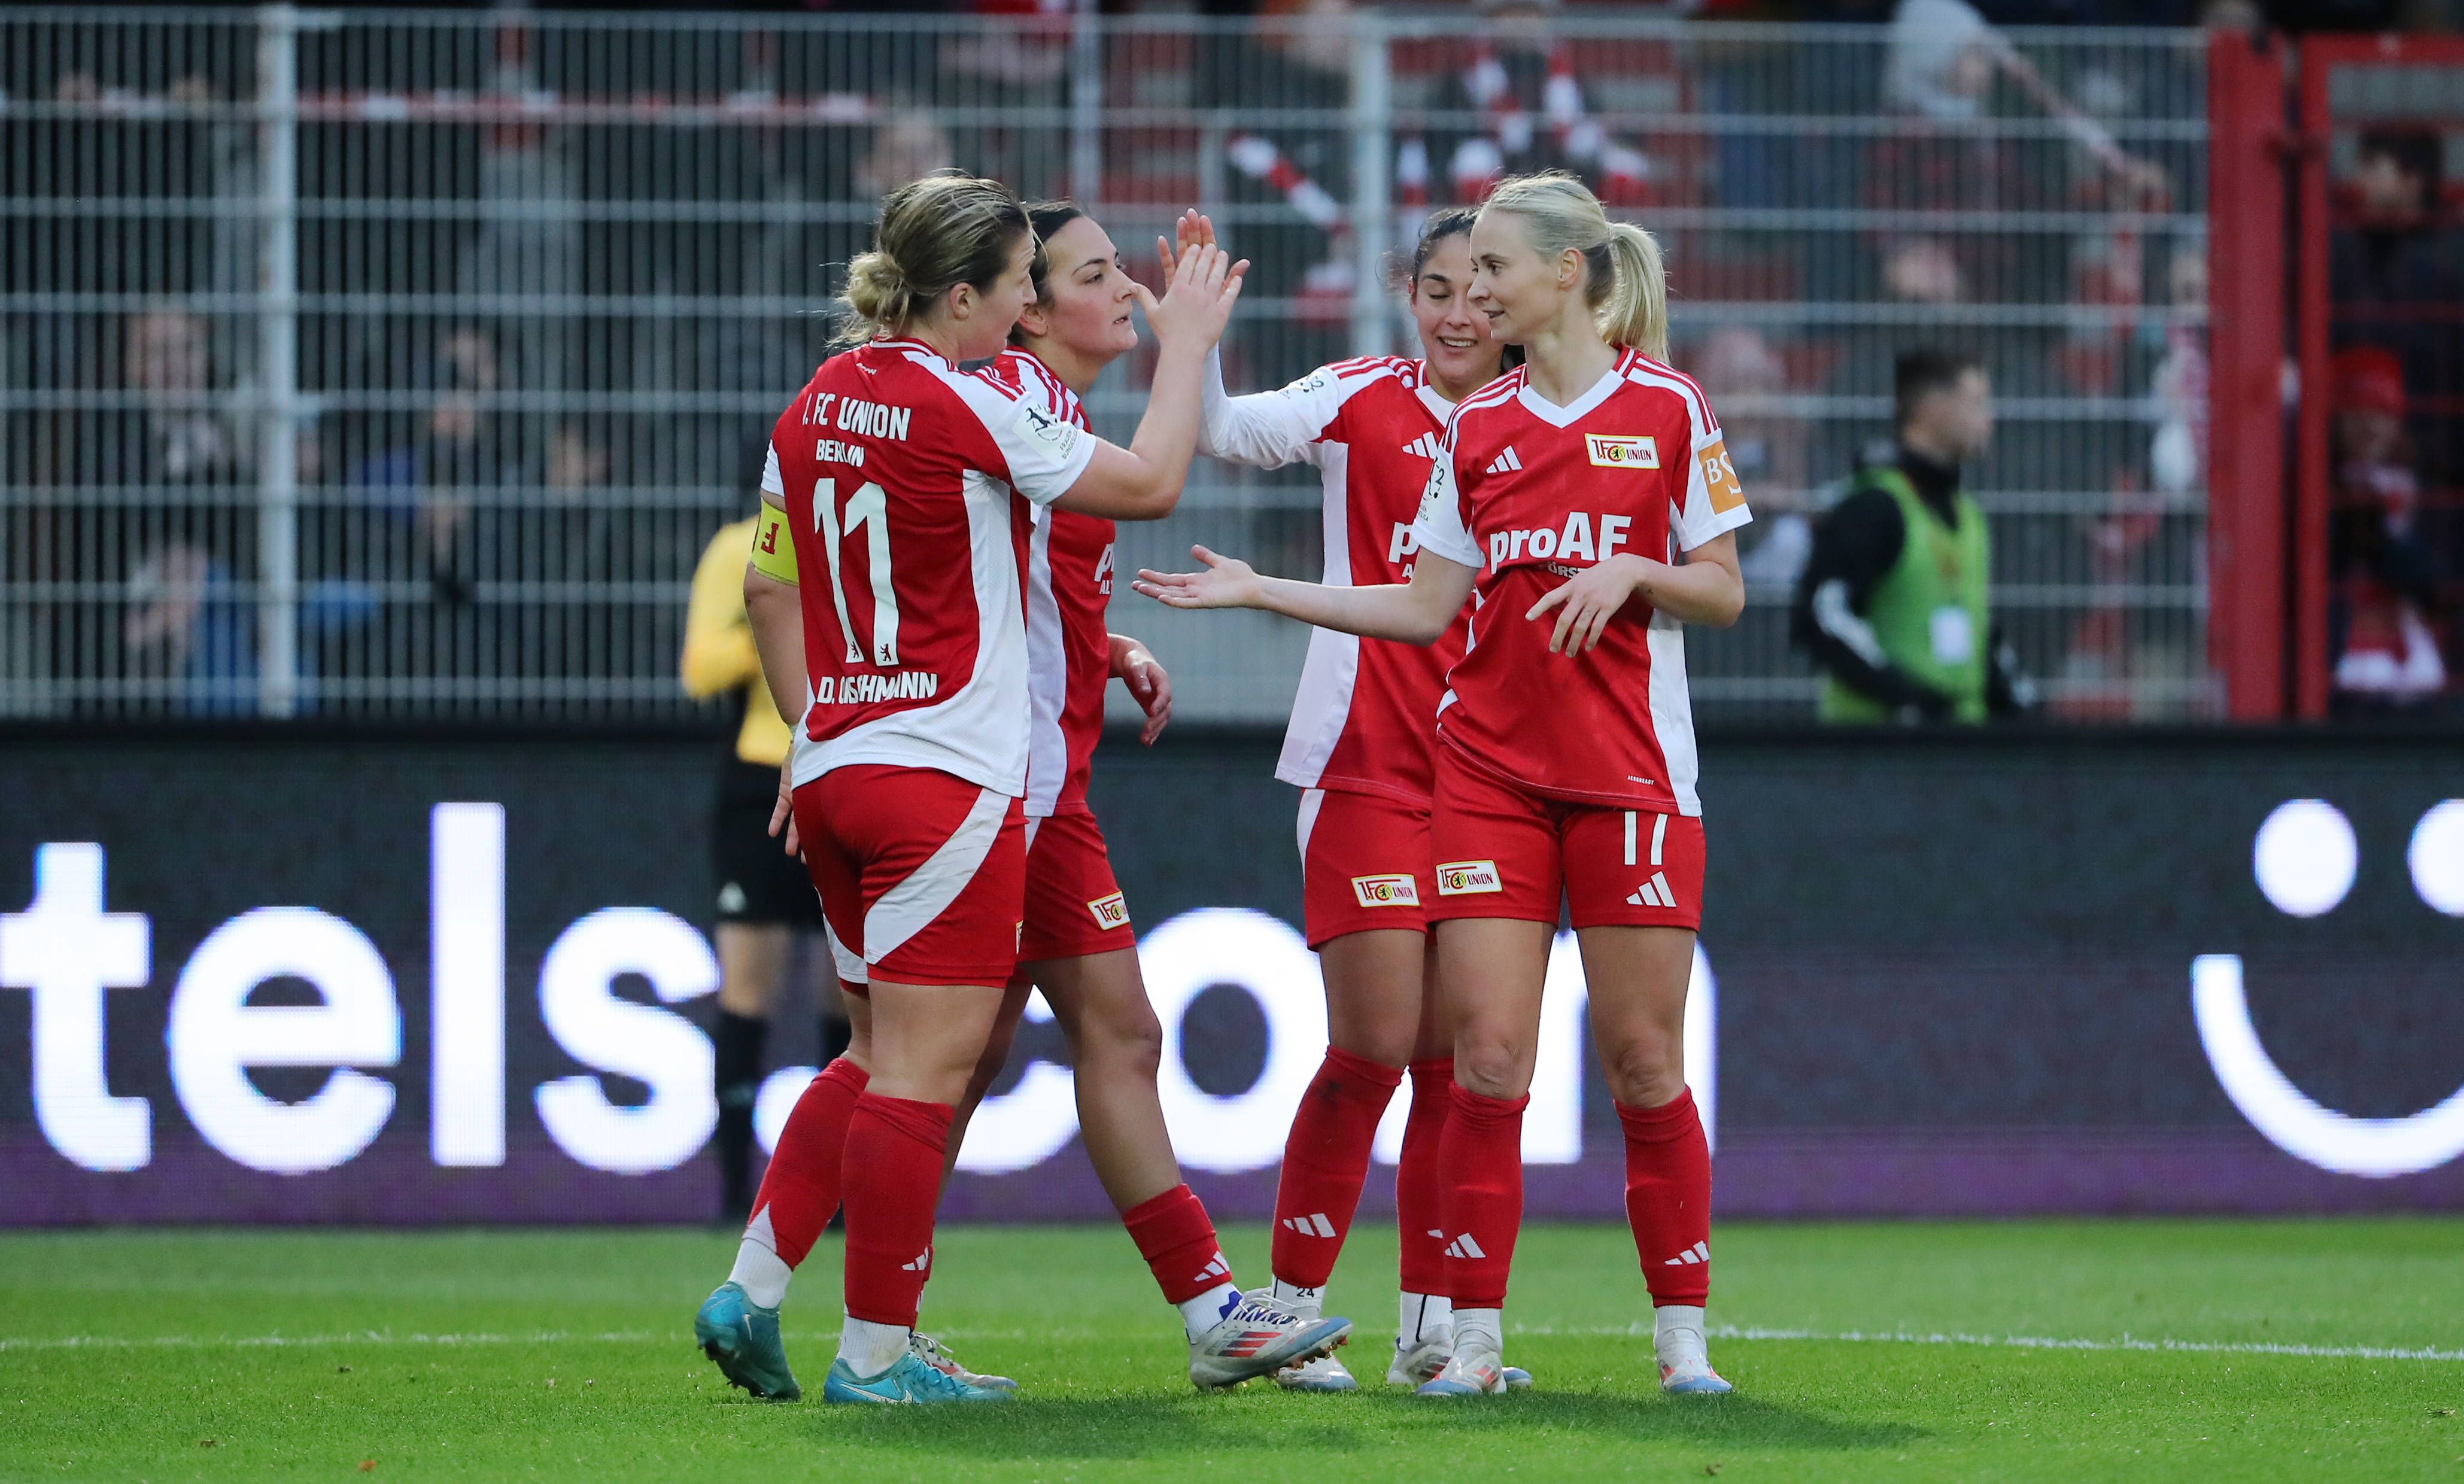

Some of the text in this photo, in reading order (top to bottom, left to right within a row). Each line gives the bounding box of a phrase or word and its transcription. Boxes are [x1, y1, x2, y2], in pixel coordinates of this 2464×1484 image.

[802, 393, 911, 442] 1. FC UNION
[815, 439, 865, 467] BERLIN
[1626, 449, 1652, 460] UNION
[1388, 521, 1419, 563] p
[1490, 511, 1632, 574] proAF
[812, 478, 900, 667] 11
[1402, 563, 1414, 579] A
[1547, 561, 1580, 578] ÖRS
[816, 676, 835, 704] D.
[1627, 775, 1655, 785] AEROREADY
[1466, 873, 1494, 885] UNION
[1392, 885, 1414, 898] UNION
[1296, 1287, 1314, 1297] 24
